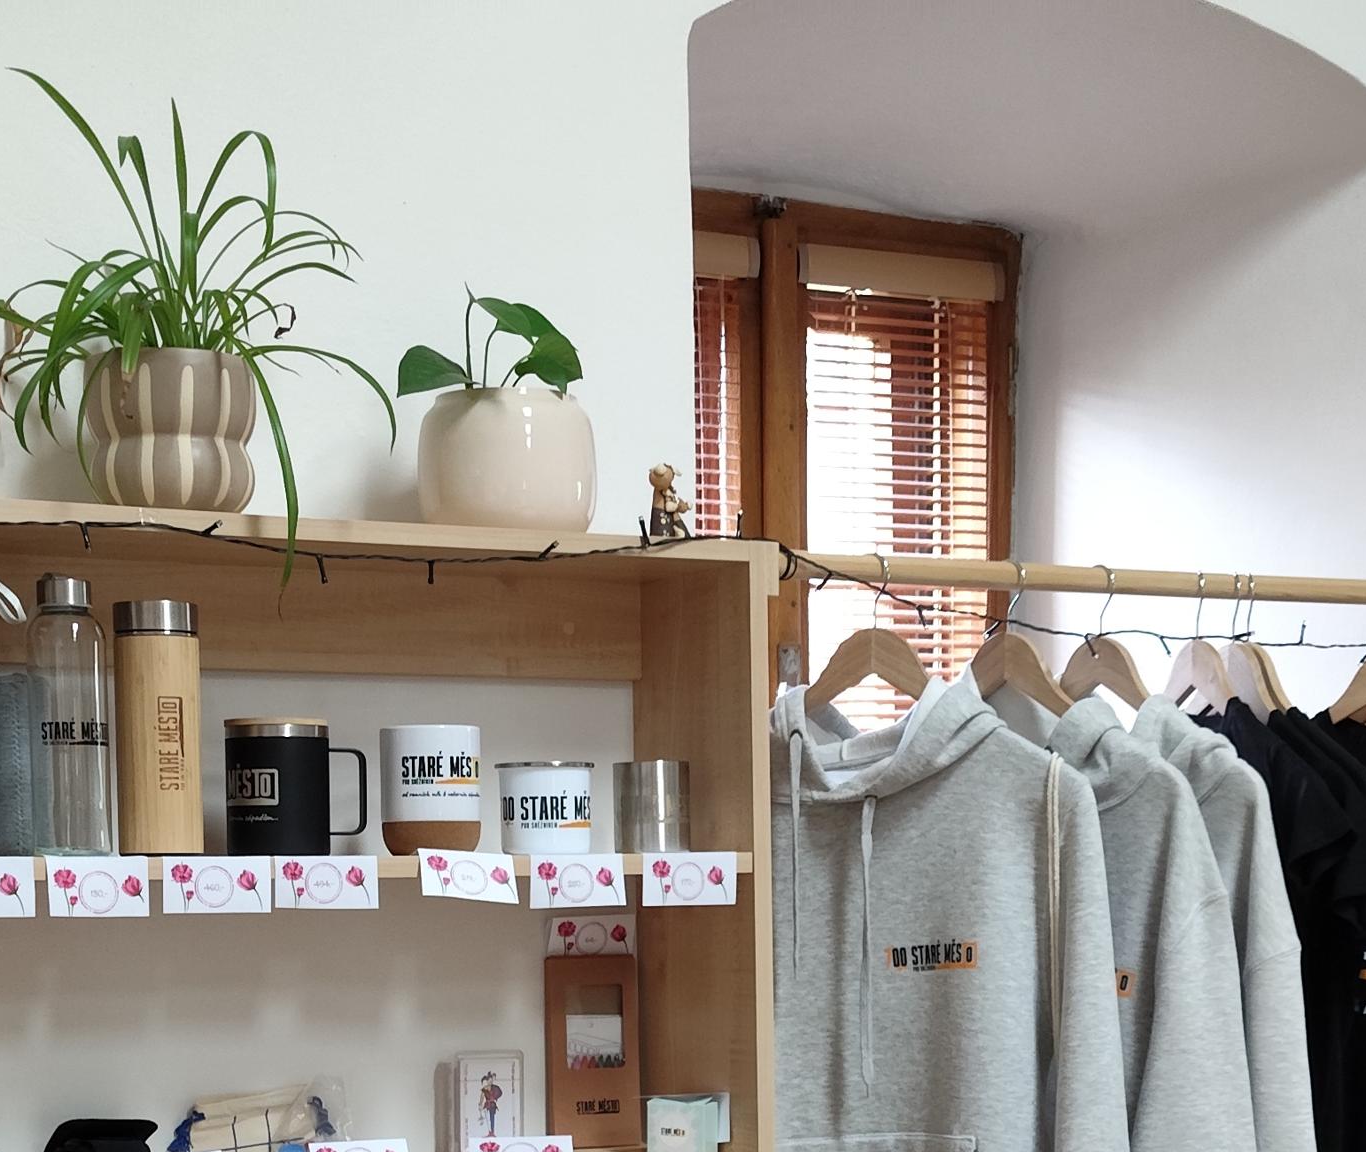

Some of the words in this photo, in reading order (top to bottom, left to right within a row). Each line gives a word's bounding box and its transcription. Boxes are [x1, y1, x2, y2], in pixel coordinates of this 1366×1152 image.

[41, 717, 76, 740] STARÉ
[154, 700, 179, 743] MĚSTO
[155, 749, 180, 791] STARÉ
[401, 750, 443, 778] STARÉ
[520, 790, 568, 821] STARÉ
[911, 939, 941, 966] STARÉ
